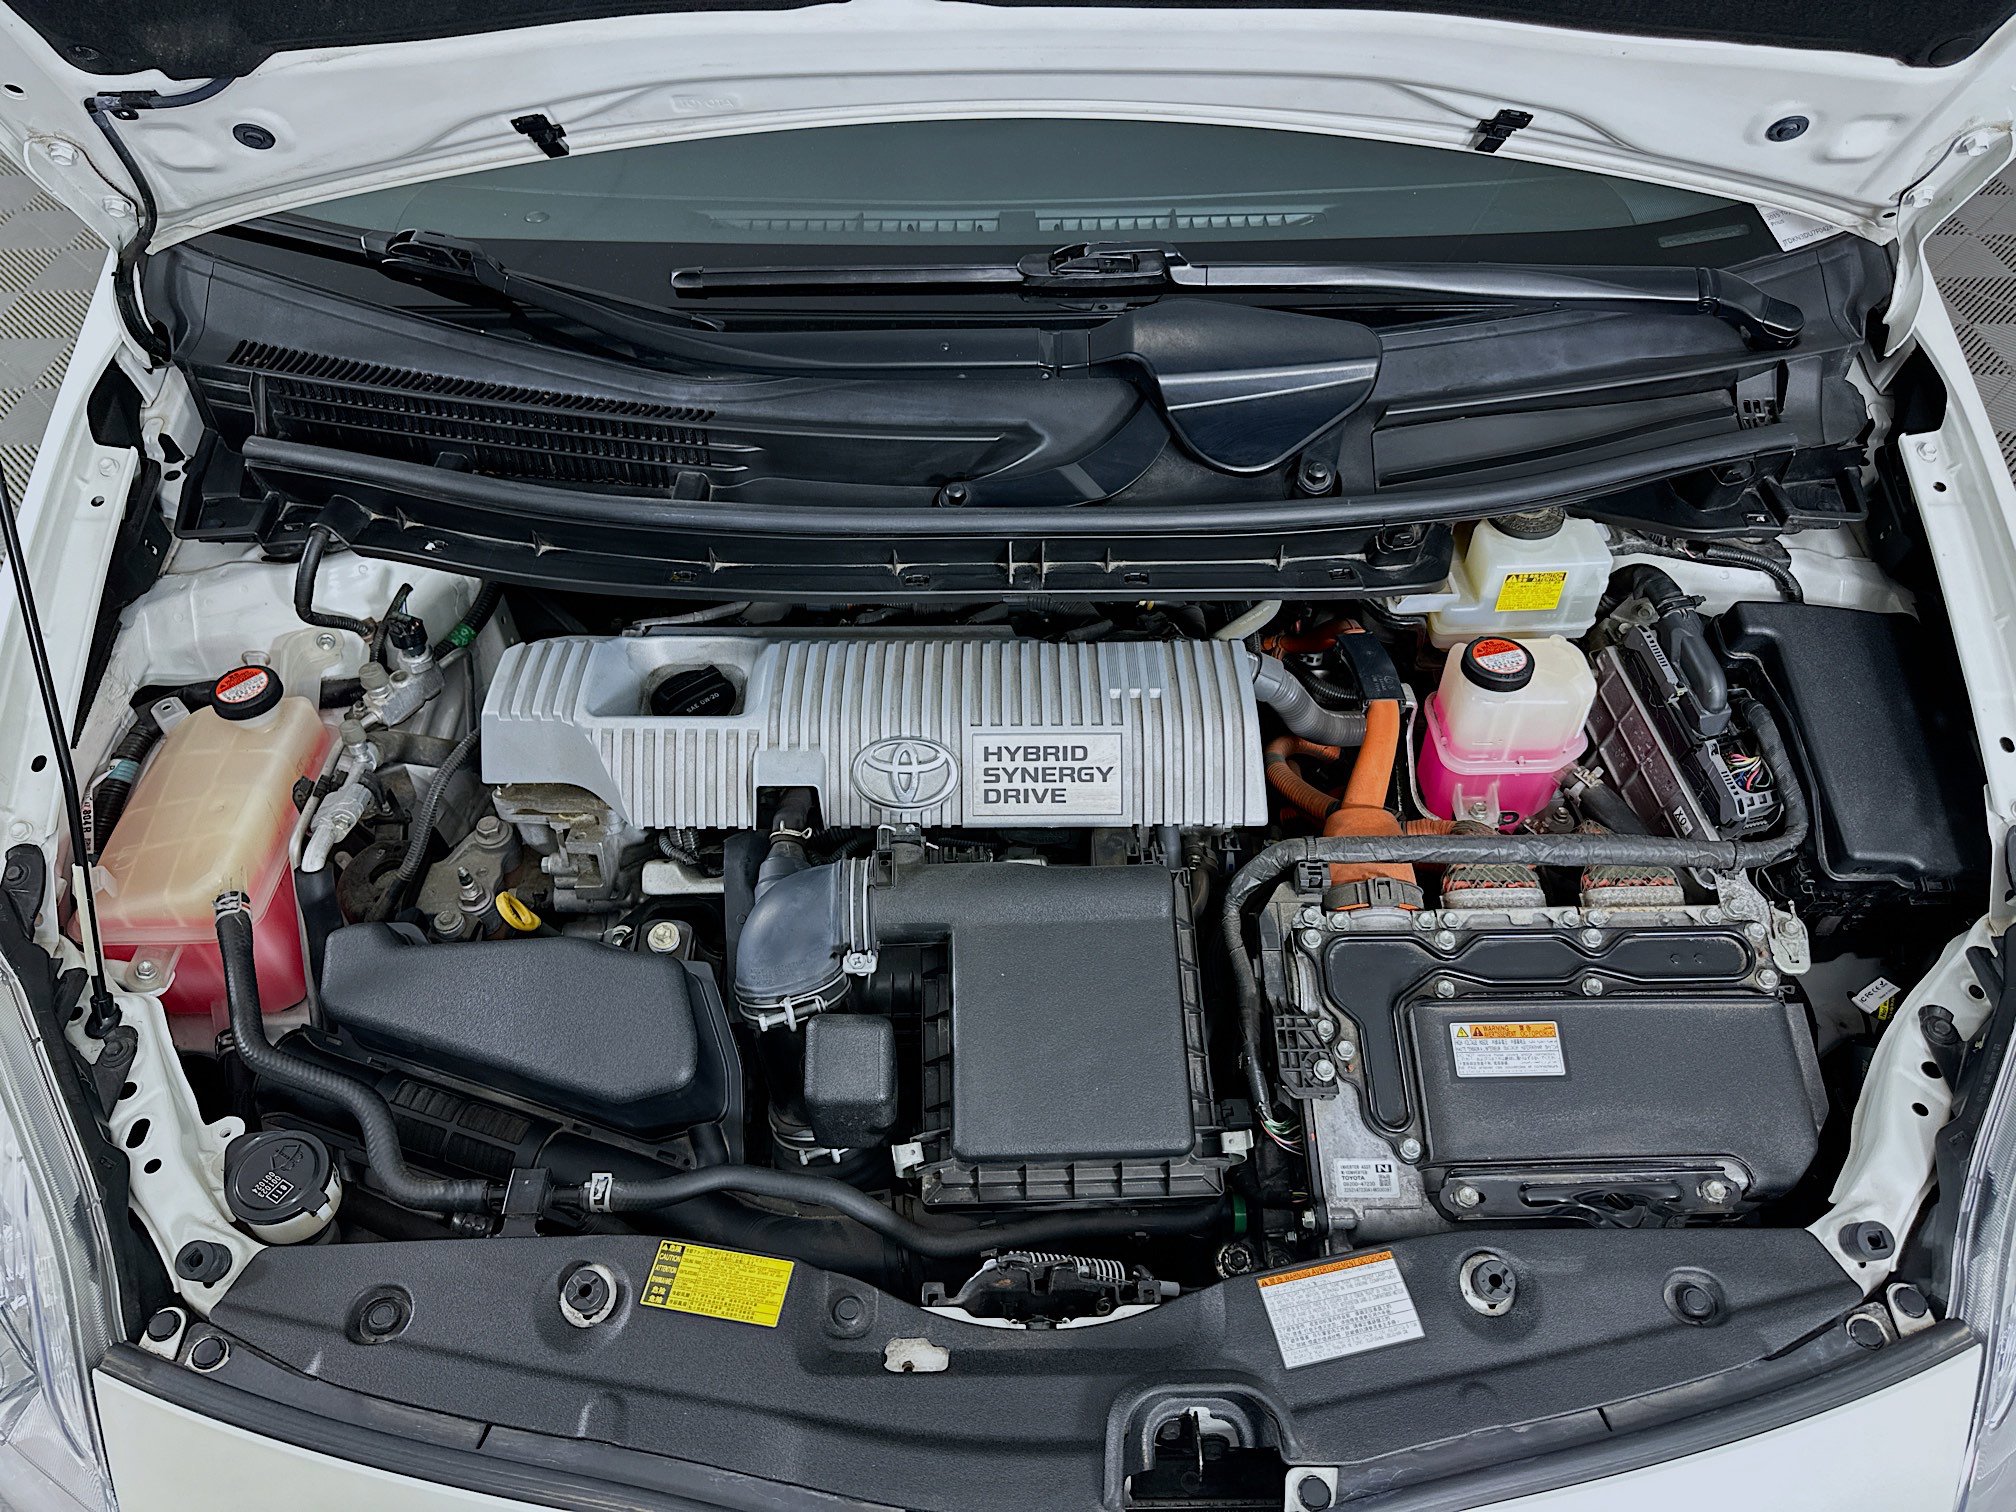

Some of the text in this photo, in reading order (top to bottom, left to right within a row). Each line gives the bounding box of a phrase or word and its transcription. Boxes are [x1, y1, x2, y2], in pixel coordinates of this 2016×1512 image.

[686, 704, 700, 713] SAE
[983, 745, 1088, 762] HYBRID
[983, 766, 1114, 783] SYNERGY
[983, 788, 1067, 804] DRIVE
[251, 1171, 276, 1194] 001024
[257, 1175, 281, 1198] 001023
[659, 1252, 682, 1262] CAUTION
[654, 1264, 678, 1274] ATTENTION
